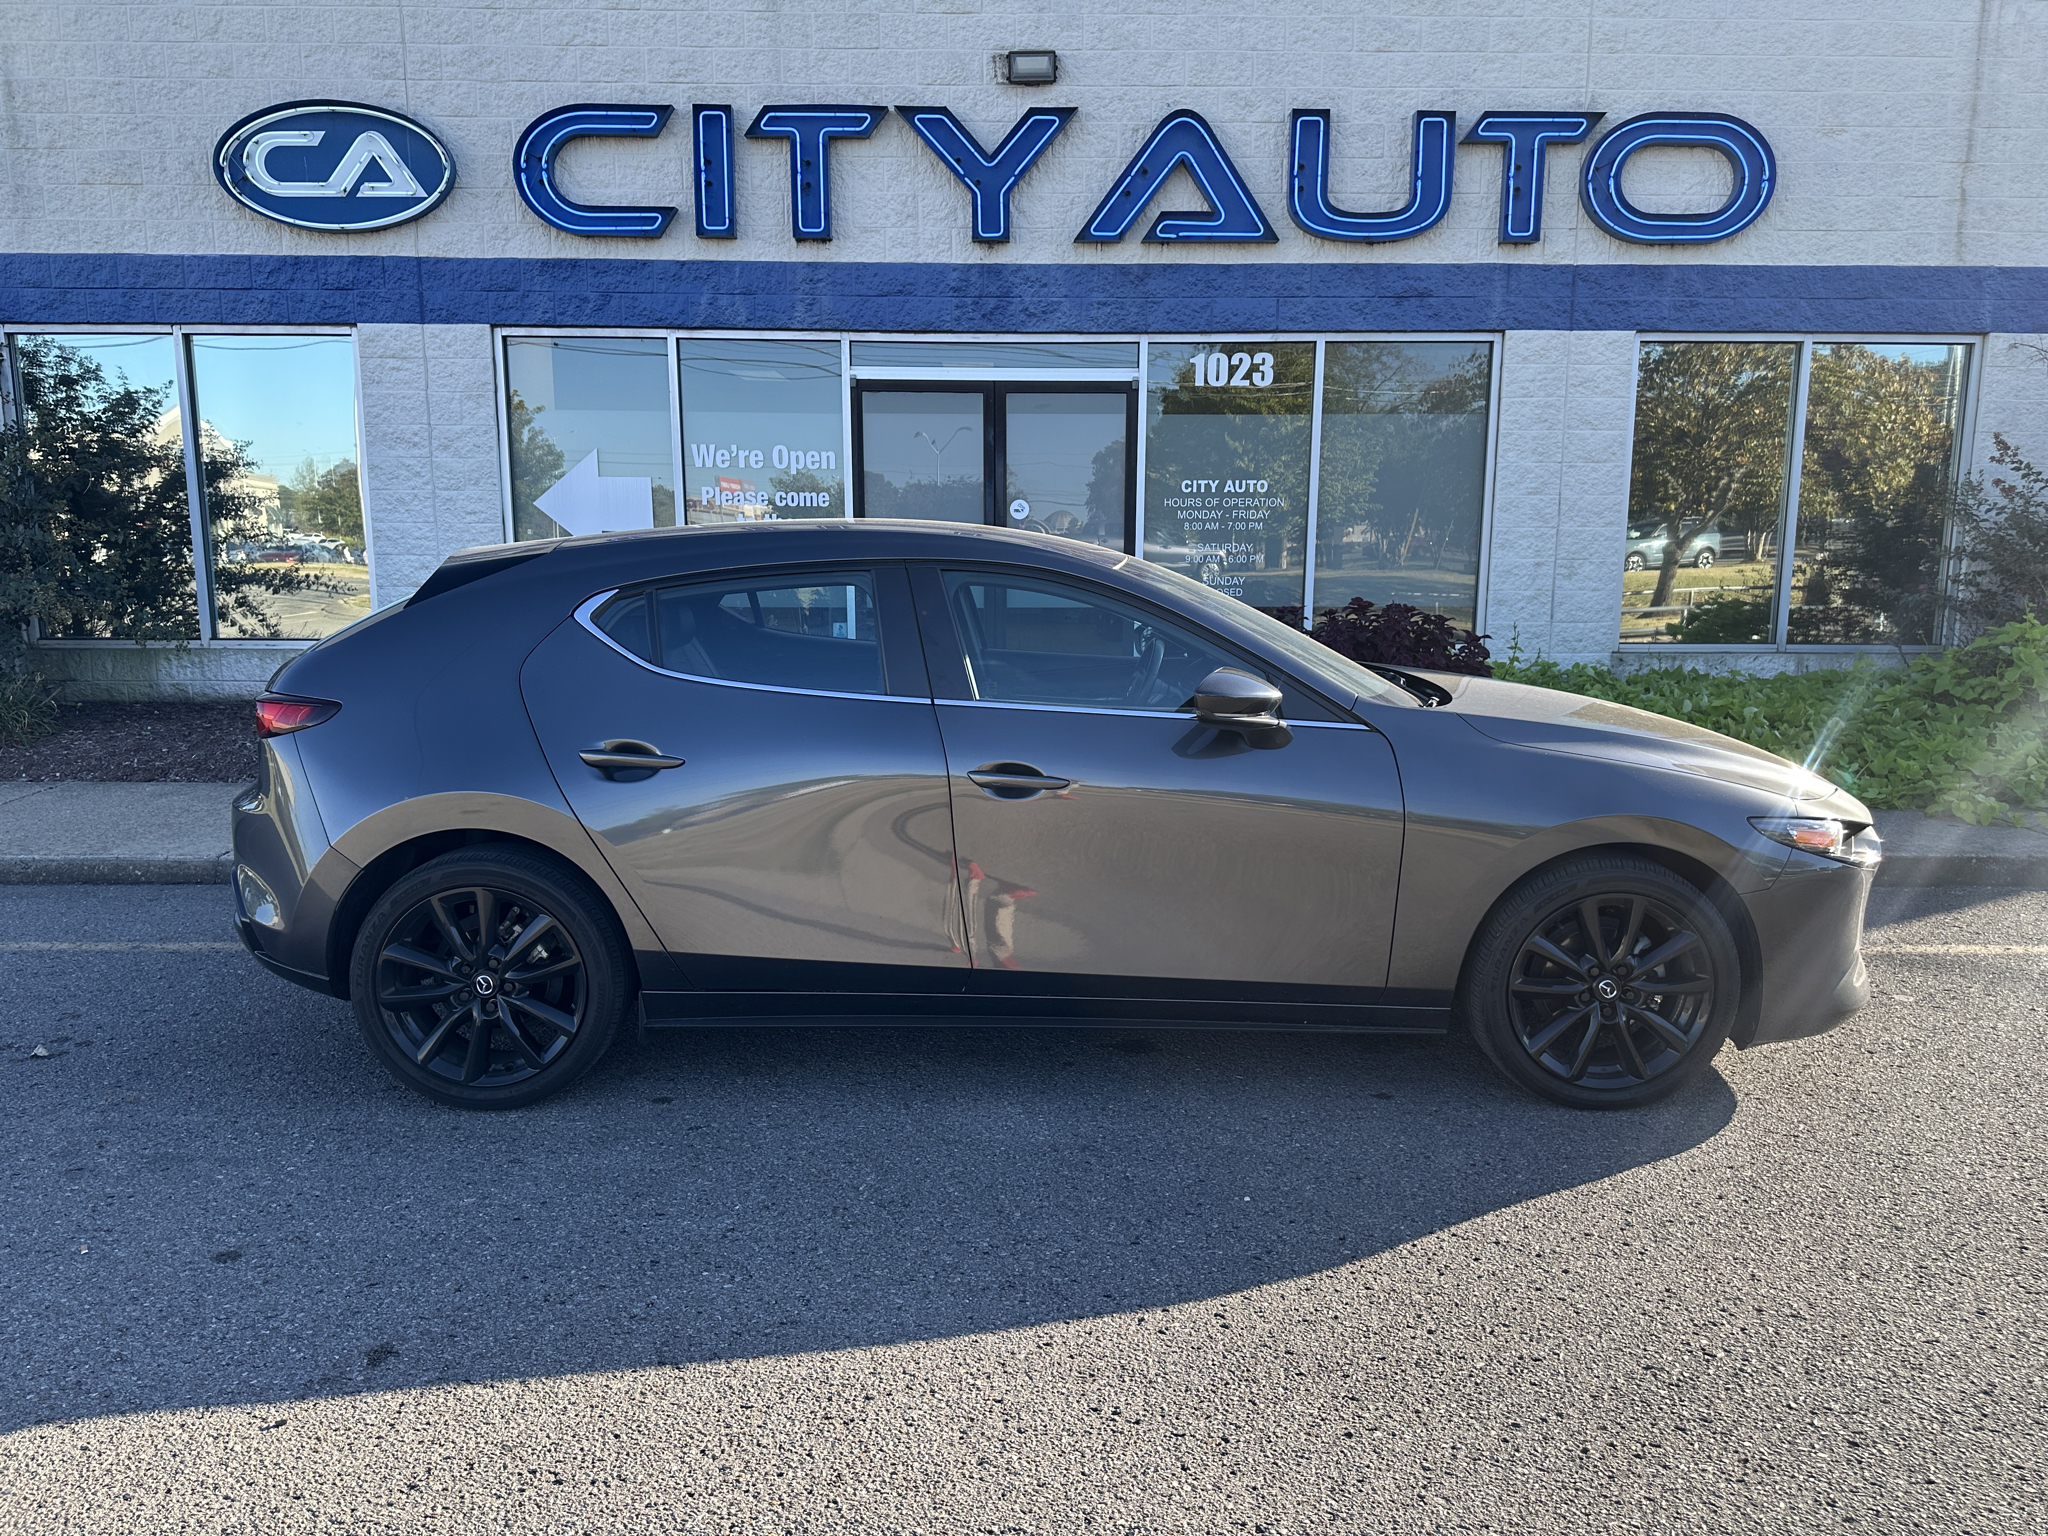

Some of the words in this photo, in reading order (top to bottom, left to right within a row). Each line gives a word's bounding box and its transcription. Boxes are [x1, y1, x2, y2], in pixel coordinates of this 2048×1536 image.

[242, 130, 429, 198] CA
[512, 103, 1079, 243] CITY
[1072, 107, 1777, 245] AUTO
[1189, 352, 1274, 387] 1023
[690, 443, 764, 469] We're
[772, 444, 836, 475] Open
[1181, 479, 1219, 493] CITY
[1223, 479, 1268, 493] AUTO
[701, 486, 769, 506] Please
[775, 491, 830, 507] come
[1164, 498, 1202, 507] HOURS
[1205, 498, 1220, 507] OF
[1222, 498, 1285, 507] OPERATION
[1177, 510, 1223, 519] MONDAY
[1232, 510, 1270, 519] FRIDAY
[1184, 522, 1203, 530] 8:00
[1205, 522, 1219, 530] AM
[1227, 522, 1246, 530] 7:00
[1248, 522, 1263, 530] PM
[1197, 543, 1253, 552] SATURDAY
[1185, 555, 1203, 563] 9:00
[1206, 555, 1220, 563] AM
[1228, 555, 1247, 563] 6:00
[1249, 555, 1264, 563] PM
[1202, 576, 1246, 586] SUNDAY
